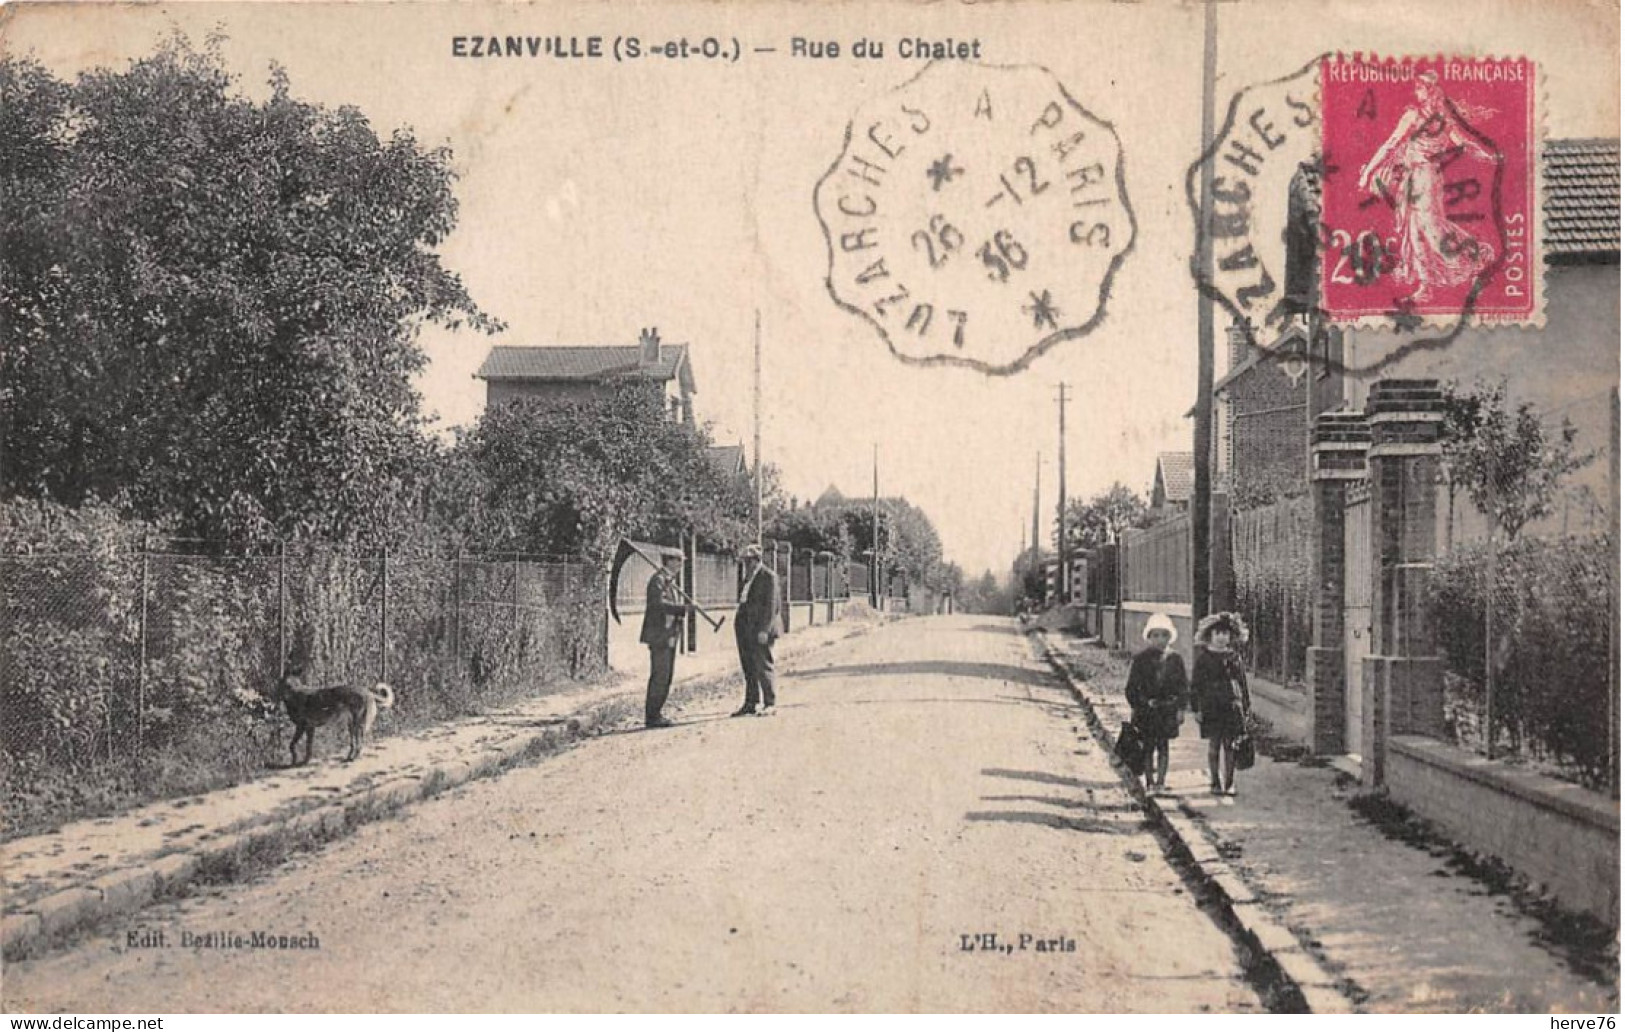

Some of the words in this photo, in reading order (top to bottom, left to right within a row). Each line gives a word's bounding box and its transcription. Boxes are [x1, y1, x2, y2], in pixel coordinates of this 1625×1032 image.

[451, 36, 603, 58] EZANVILLE
[791, 37, 840, 59] Rue
[852, 37, 884, 59] du
[899, 37, 981, 59] Chalet
[1443, 62, 1524, 83] FRANÇAISE
[911, 213, 964, 269] 26
[1504, 212, 1525, 298] POSTES
[126, 930, 172, 949] Edit.
[1018, 932, 1077, 953] Paris
